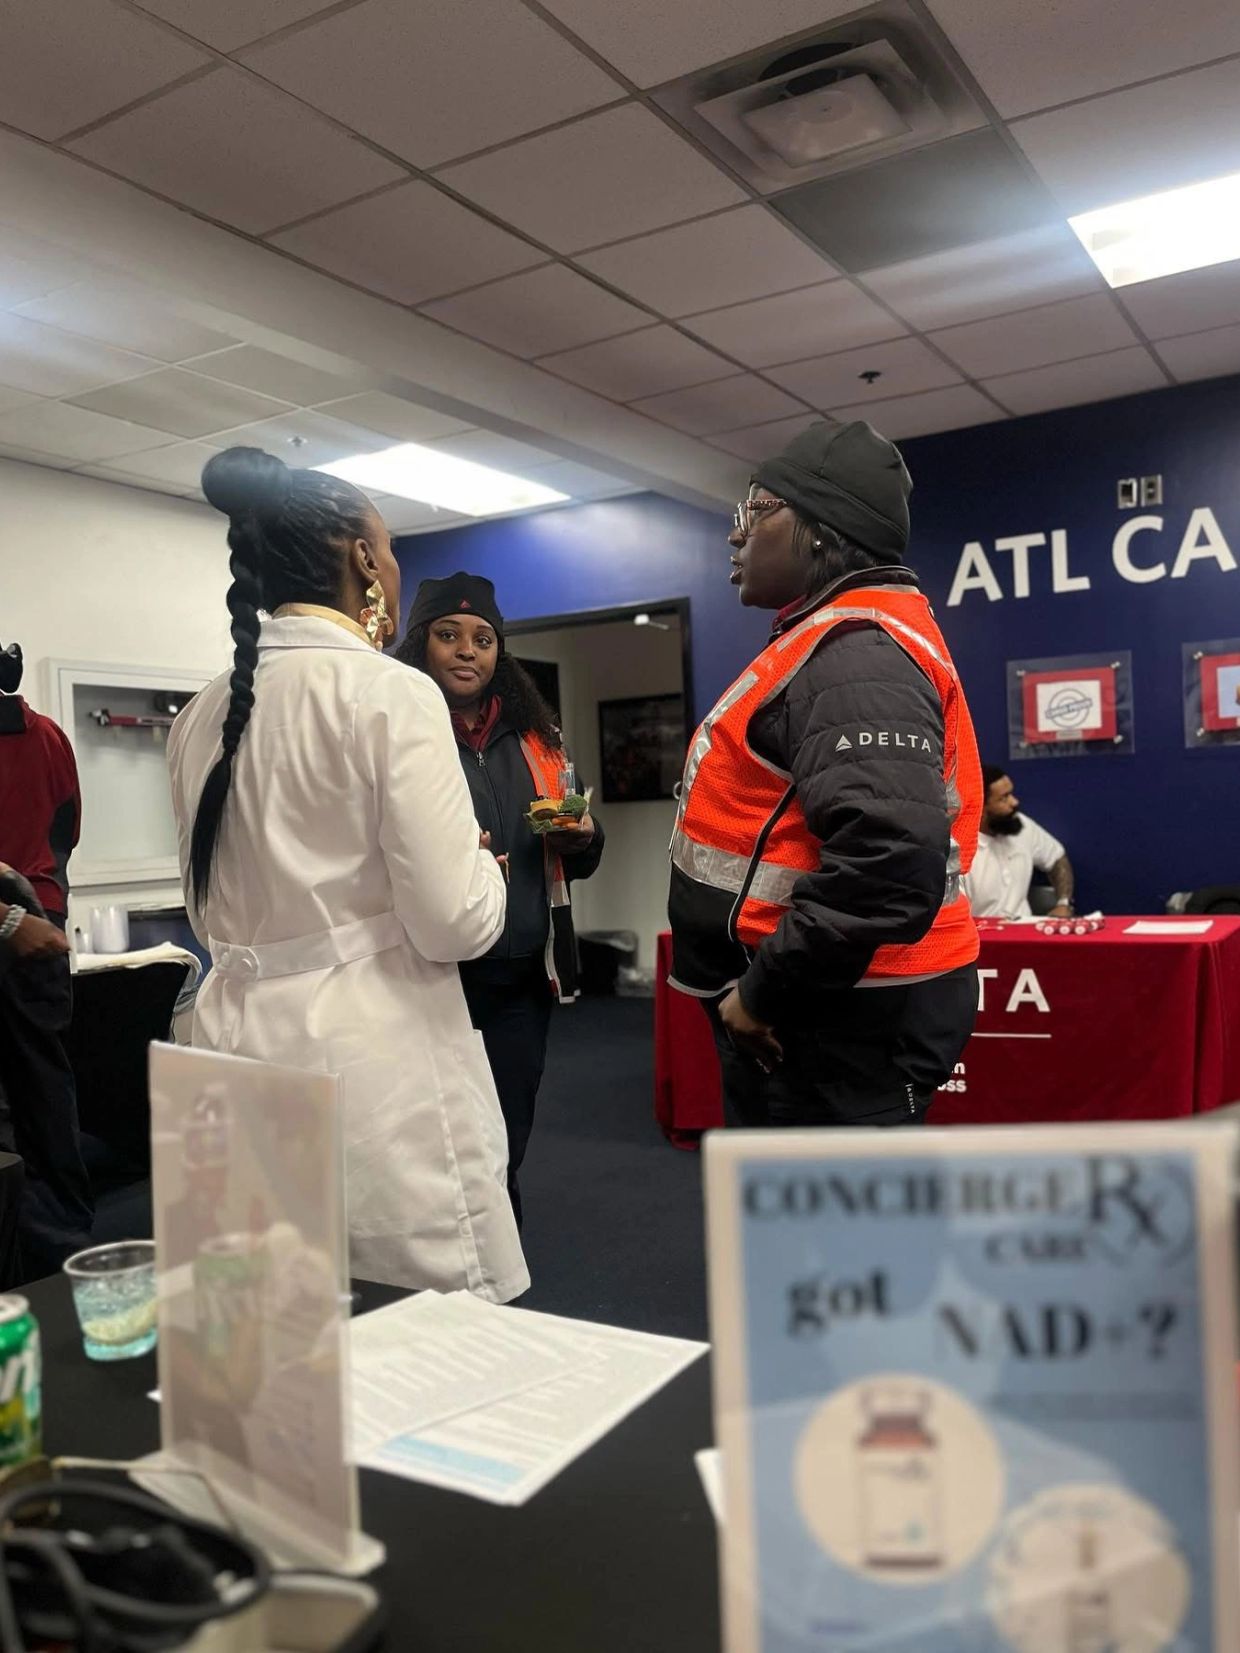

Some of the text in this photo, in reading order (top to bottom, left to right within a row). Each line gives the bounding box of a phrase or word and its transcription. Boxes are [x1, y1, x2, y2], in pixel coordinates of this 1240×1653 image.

[947, 506, 1238, 606] ATL CA
[858, 732, 931, 753] DELTA
[787, 1268, 889, 1339] got
